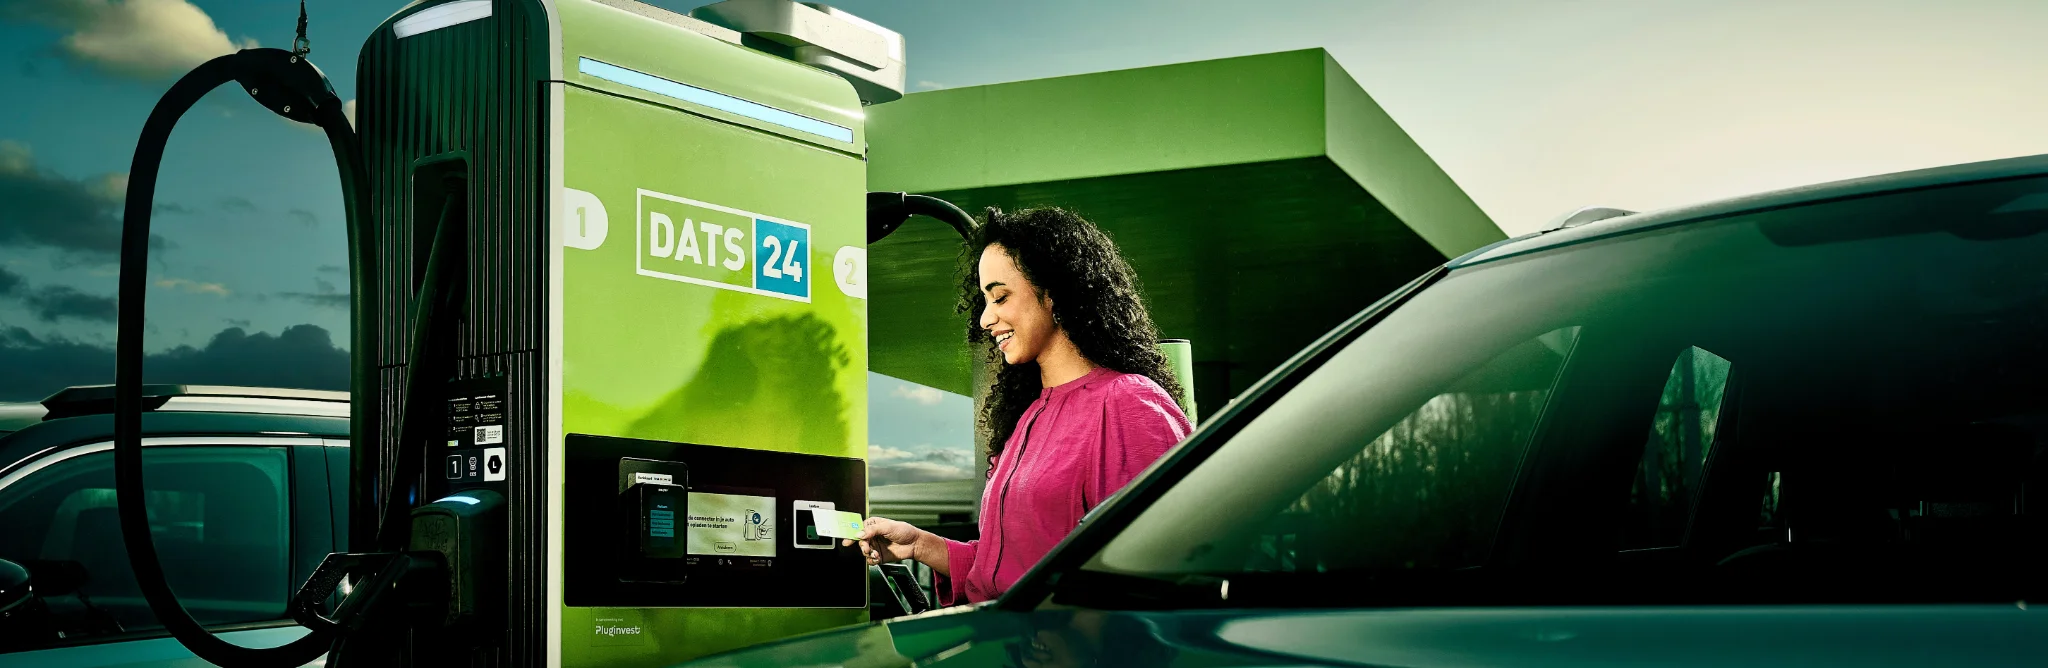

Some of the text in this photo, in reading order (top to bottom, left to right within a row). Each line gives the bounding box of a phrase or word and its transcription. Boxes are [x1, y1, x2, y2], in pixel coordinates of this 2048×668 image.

[576, 206, 587, 238] 1
[650, 211, 803, 283] DATS 24
[844, 258, 857, 285] 2
[452, 460, 458, 474] 1
[595, 625, 641, 637] Pluginvest
